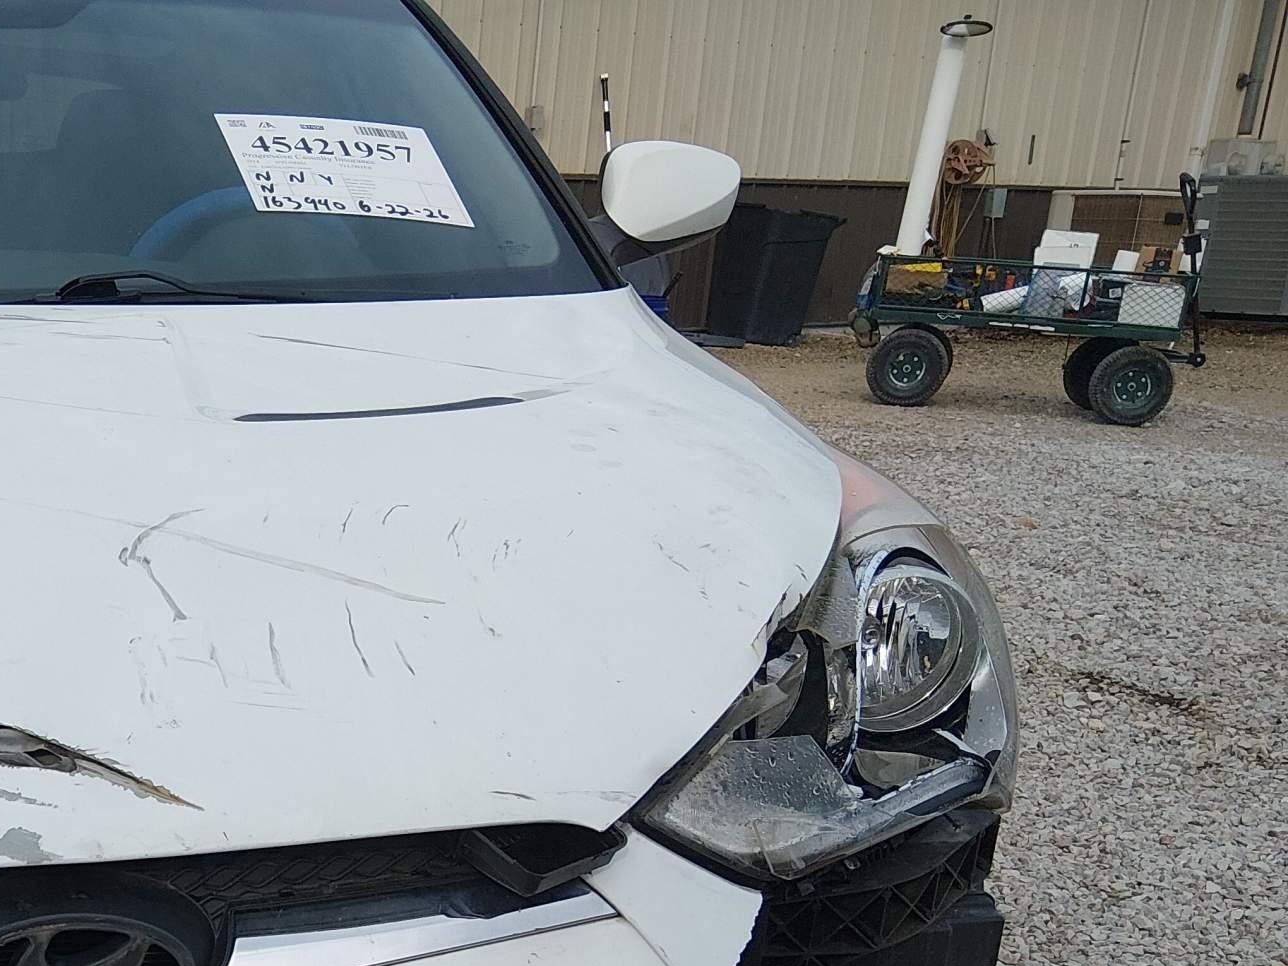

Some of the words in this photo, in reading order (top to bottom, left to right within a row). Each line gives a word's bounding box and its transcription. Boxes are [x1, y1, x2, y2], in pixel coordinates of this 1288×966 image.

[251, 135, 411, 163] 45421957
[255, 171, 271, 182] N
[289, 171, 305, 183] N
[260, 183, 275, 193] N
[358, 200, 449, 220] 6-22-26
